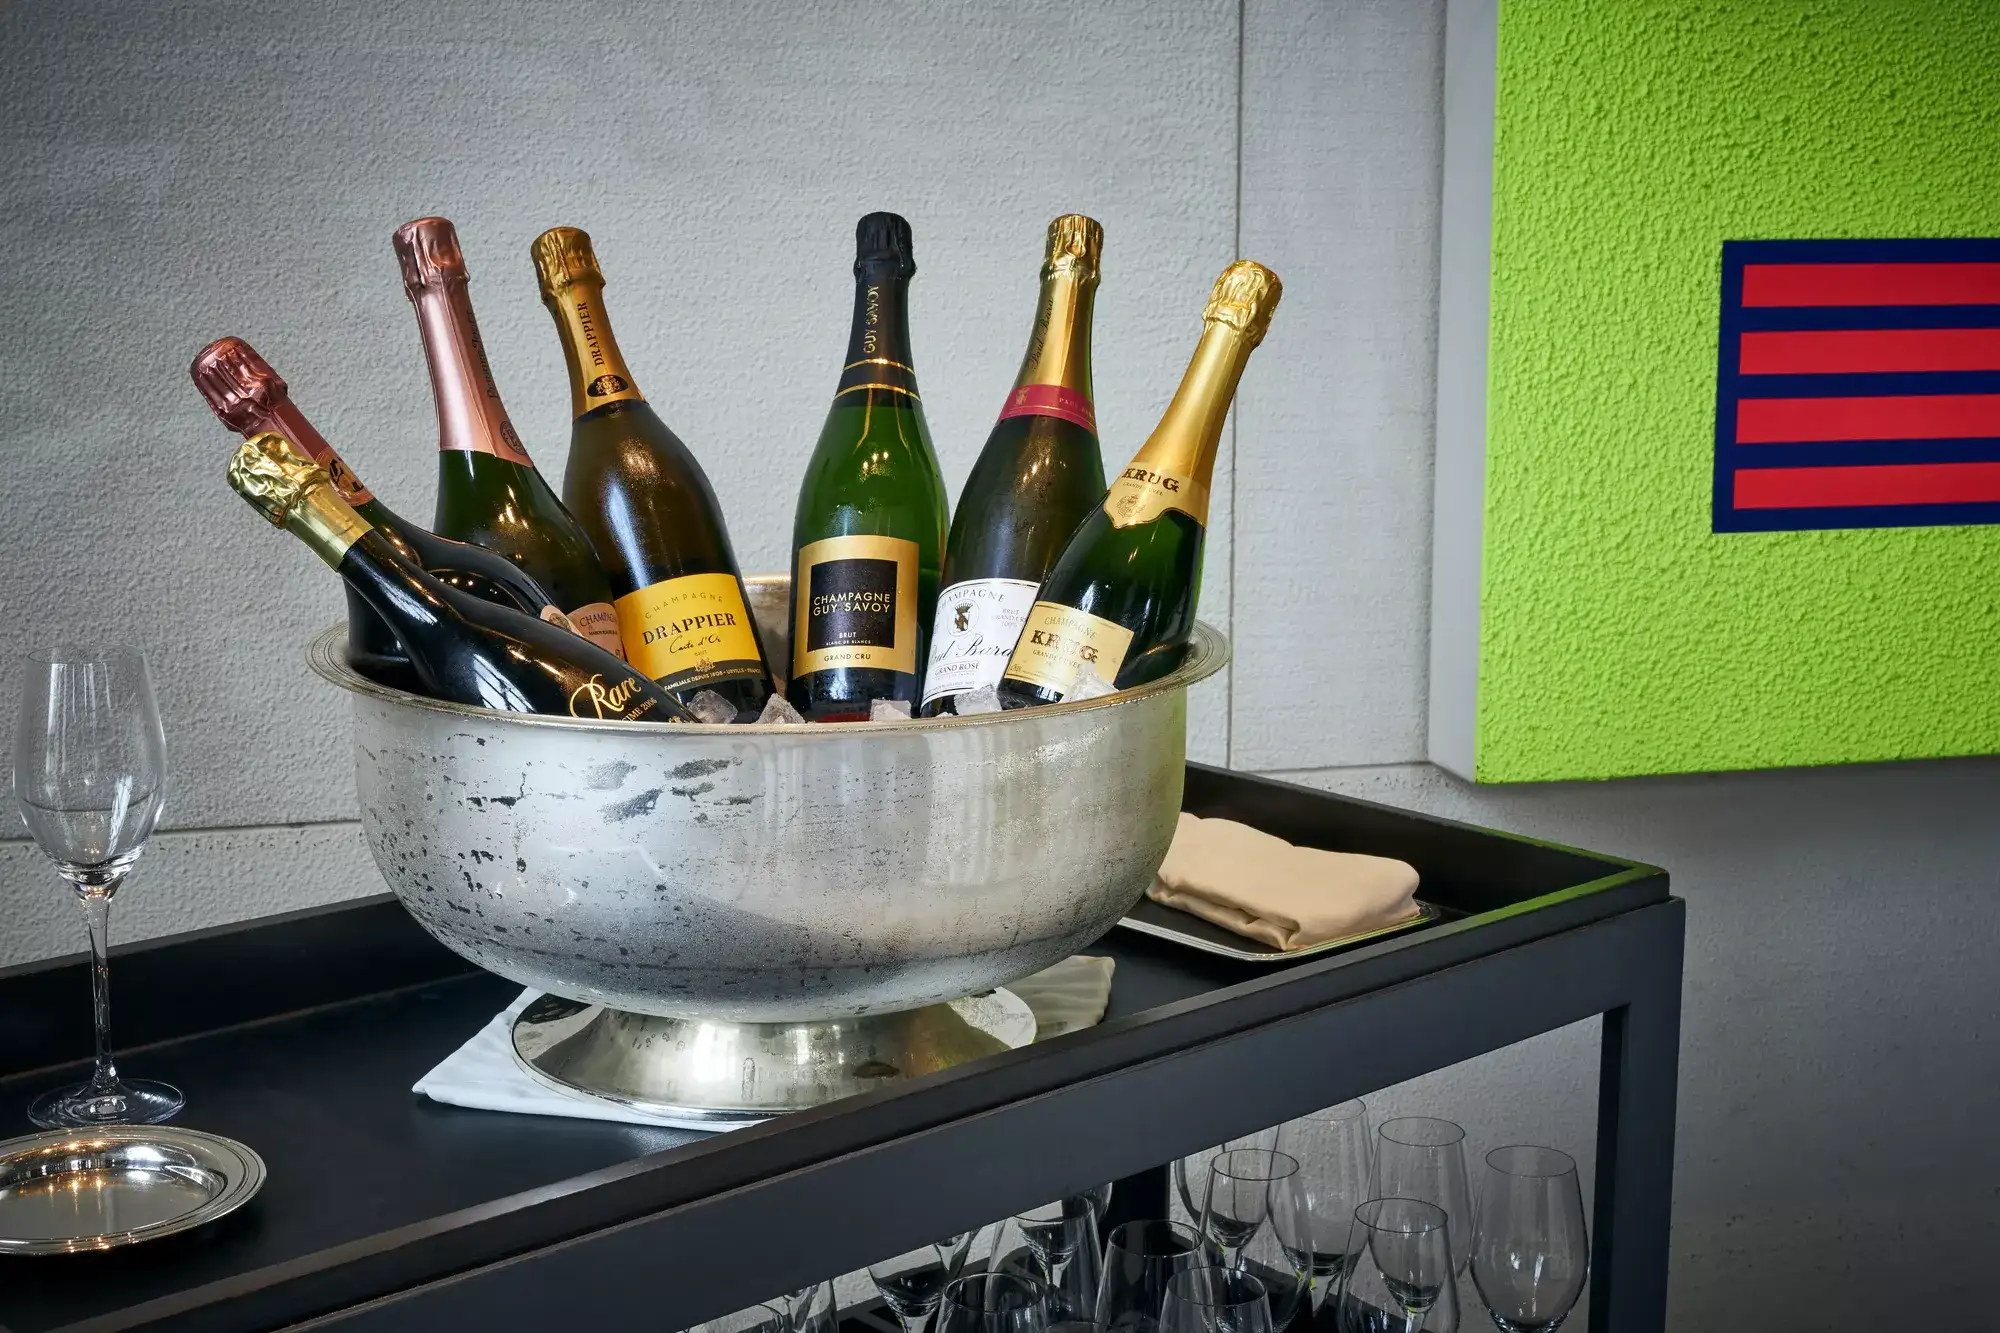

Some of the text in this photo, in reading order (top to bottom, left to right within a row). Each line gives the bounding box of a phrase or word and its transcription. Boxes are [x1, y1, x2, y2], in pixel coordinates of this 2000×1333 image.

[863, 285, 879, 354] GUY SAVOY
[577, 301, 605, 367] DRAPPIER
[1121, 467, 1180, 493] KRUG
[644, 591, 724, 620] CHAMPAGNE
[813, 592, 891, 606] CHAMPAGNE
[813, 602, 891, 616] GUY SAVOY
[641, 612, 737, 646] DRAPPIER
[1043, 615, 1097, 641] CHAMPAGNE
[669, 635, 695, 654] Carte
[823, 653, 852, 662] GRAND
[1029, 629, 1099, 664] KRUG
[569, 673, 642, 720] Rare
[664, 677, 692, 691] FAMILIALE
